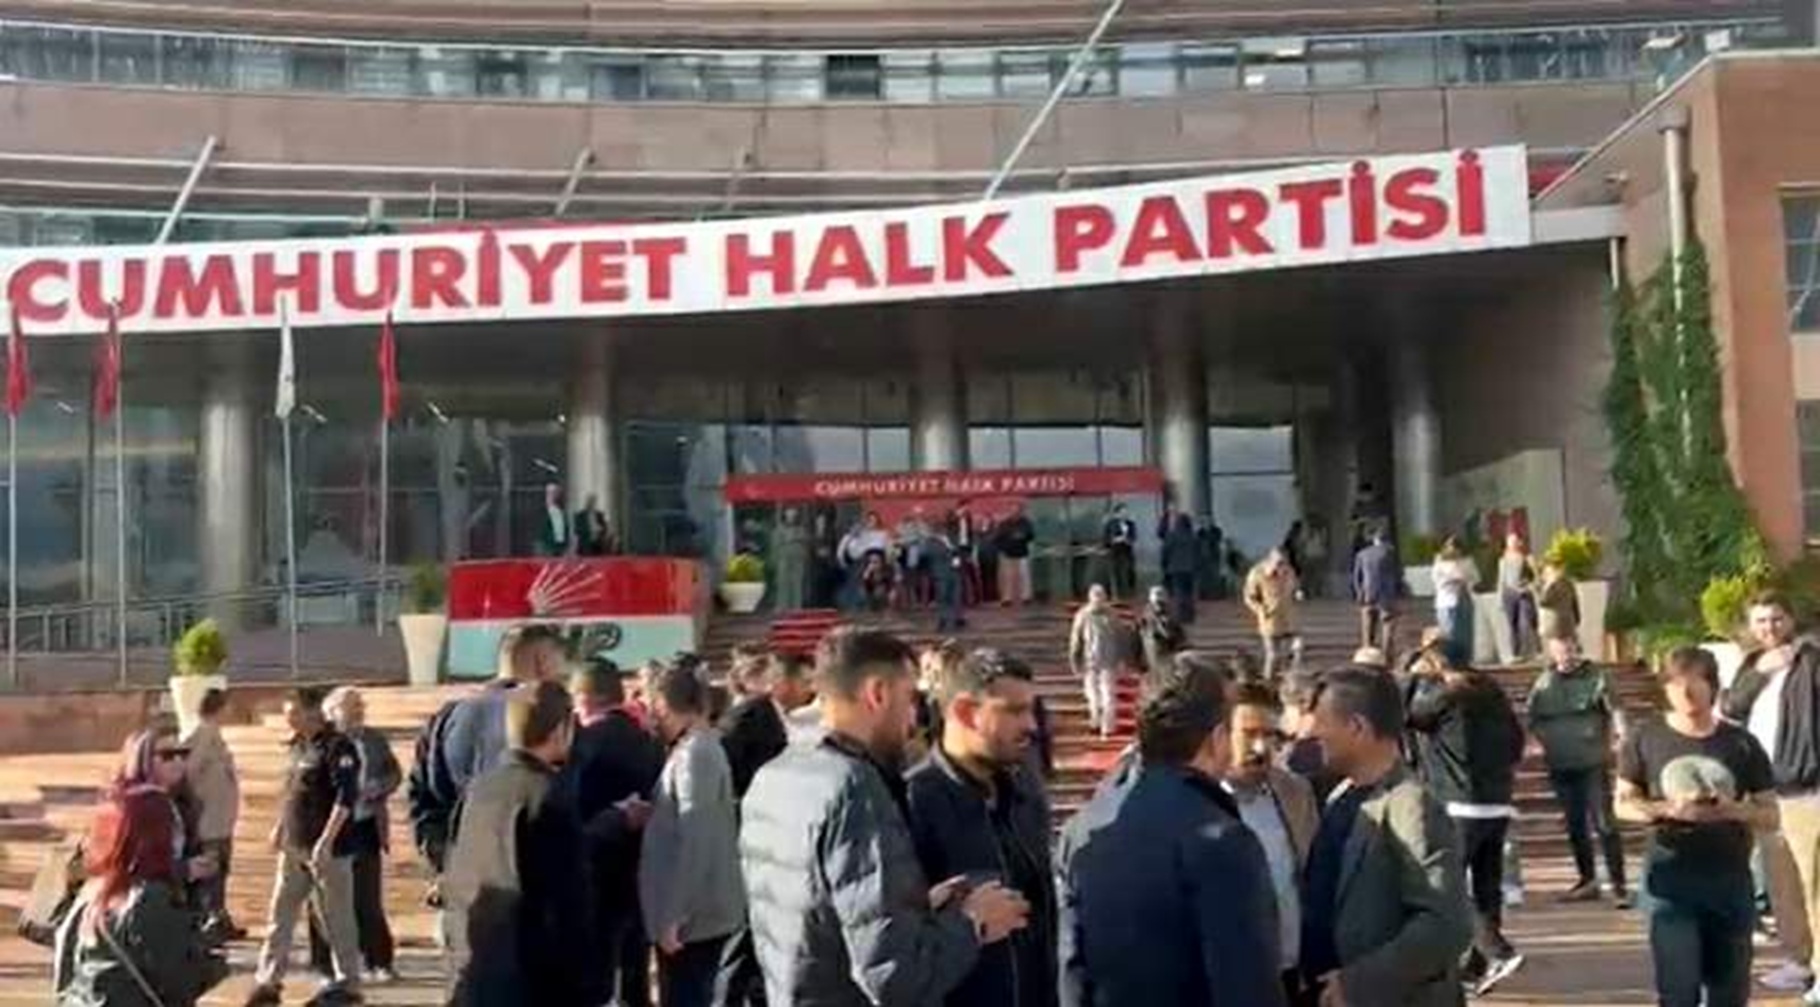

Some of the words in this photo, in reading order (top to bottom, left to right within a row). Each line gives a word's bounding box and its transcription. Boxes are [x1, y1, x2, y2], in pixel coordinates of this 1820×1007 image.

[8, 228, 687, 321] CUMHURİYET
[726, 213, 1010, 296] HALK
[1054, 150, 1486, 271] PARTİSİ
